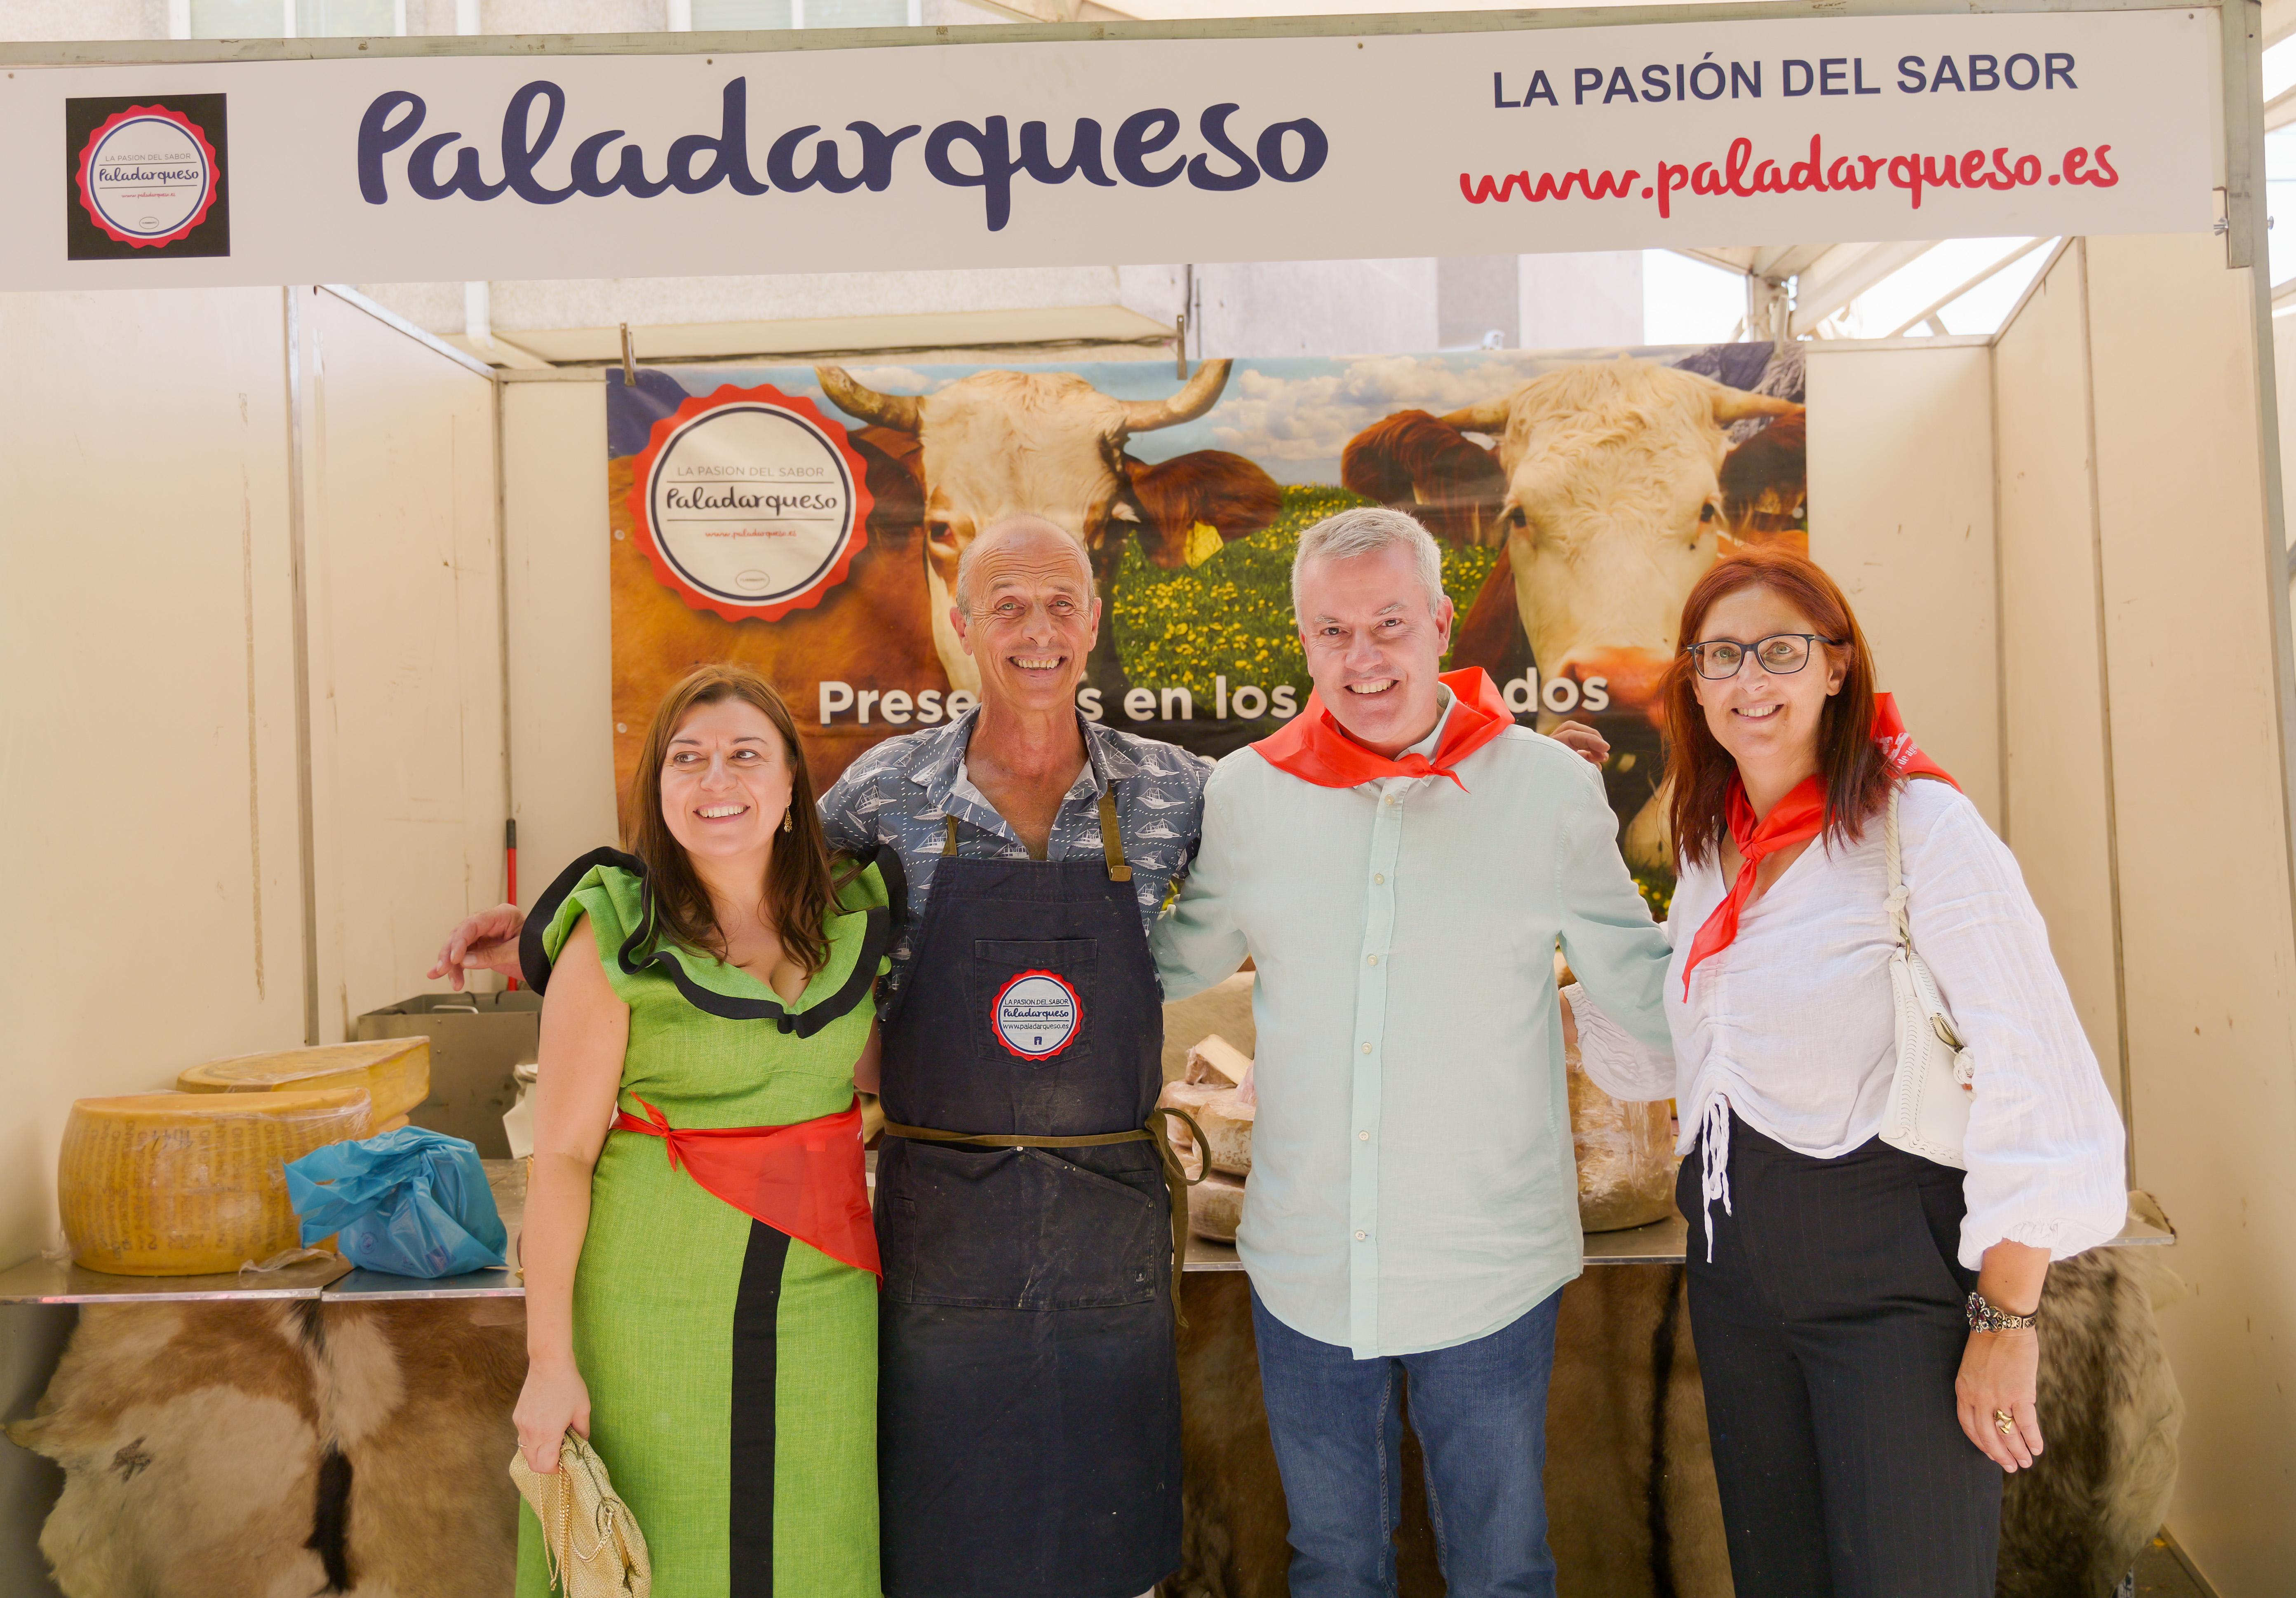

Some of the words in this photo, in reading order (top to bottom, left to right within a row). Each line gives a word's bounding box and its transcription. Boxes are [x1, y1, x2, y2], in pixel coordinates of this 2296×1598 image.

[1494, 70, 1558, 108] LA
[1575, 52, 1761, 105] PASIÓN
[1783, 58, 1880, 96] DEL
[1897, 53, 2078, 94] SABOR
[358, 76, 1328, 231] Paladarqueso
[99, 167, 199, 185] Paladarqueso
[1460, 134, 2119, 218] www.paladarqueso.es
[678, 466, 694, 476] LA
[698, 466, 745, 476] PASION
[750, 467, 774, 476] DEL
[779, 467, 824, 477] SABOR
[666, 486, 837, 516] Paladarqueso
[705, 529, 797, 539] www.paladarqueso.es
[1123, 687, 1192, 721] en
[1215, 675, 1297, 719] los
[1003, 1008, 1069, 1021] Paladarqueso
